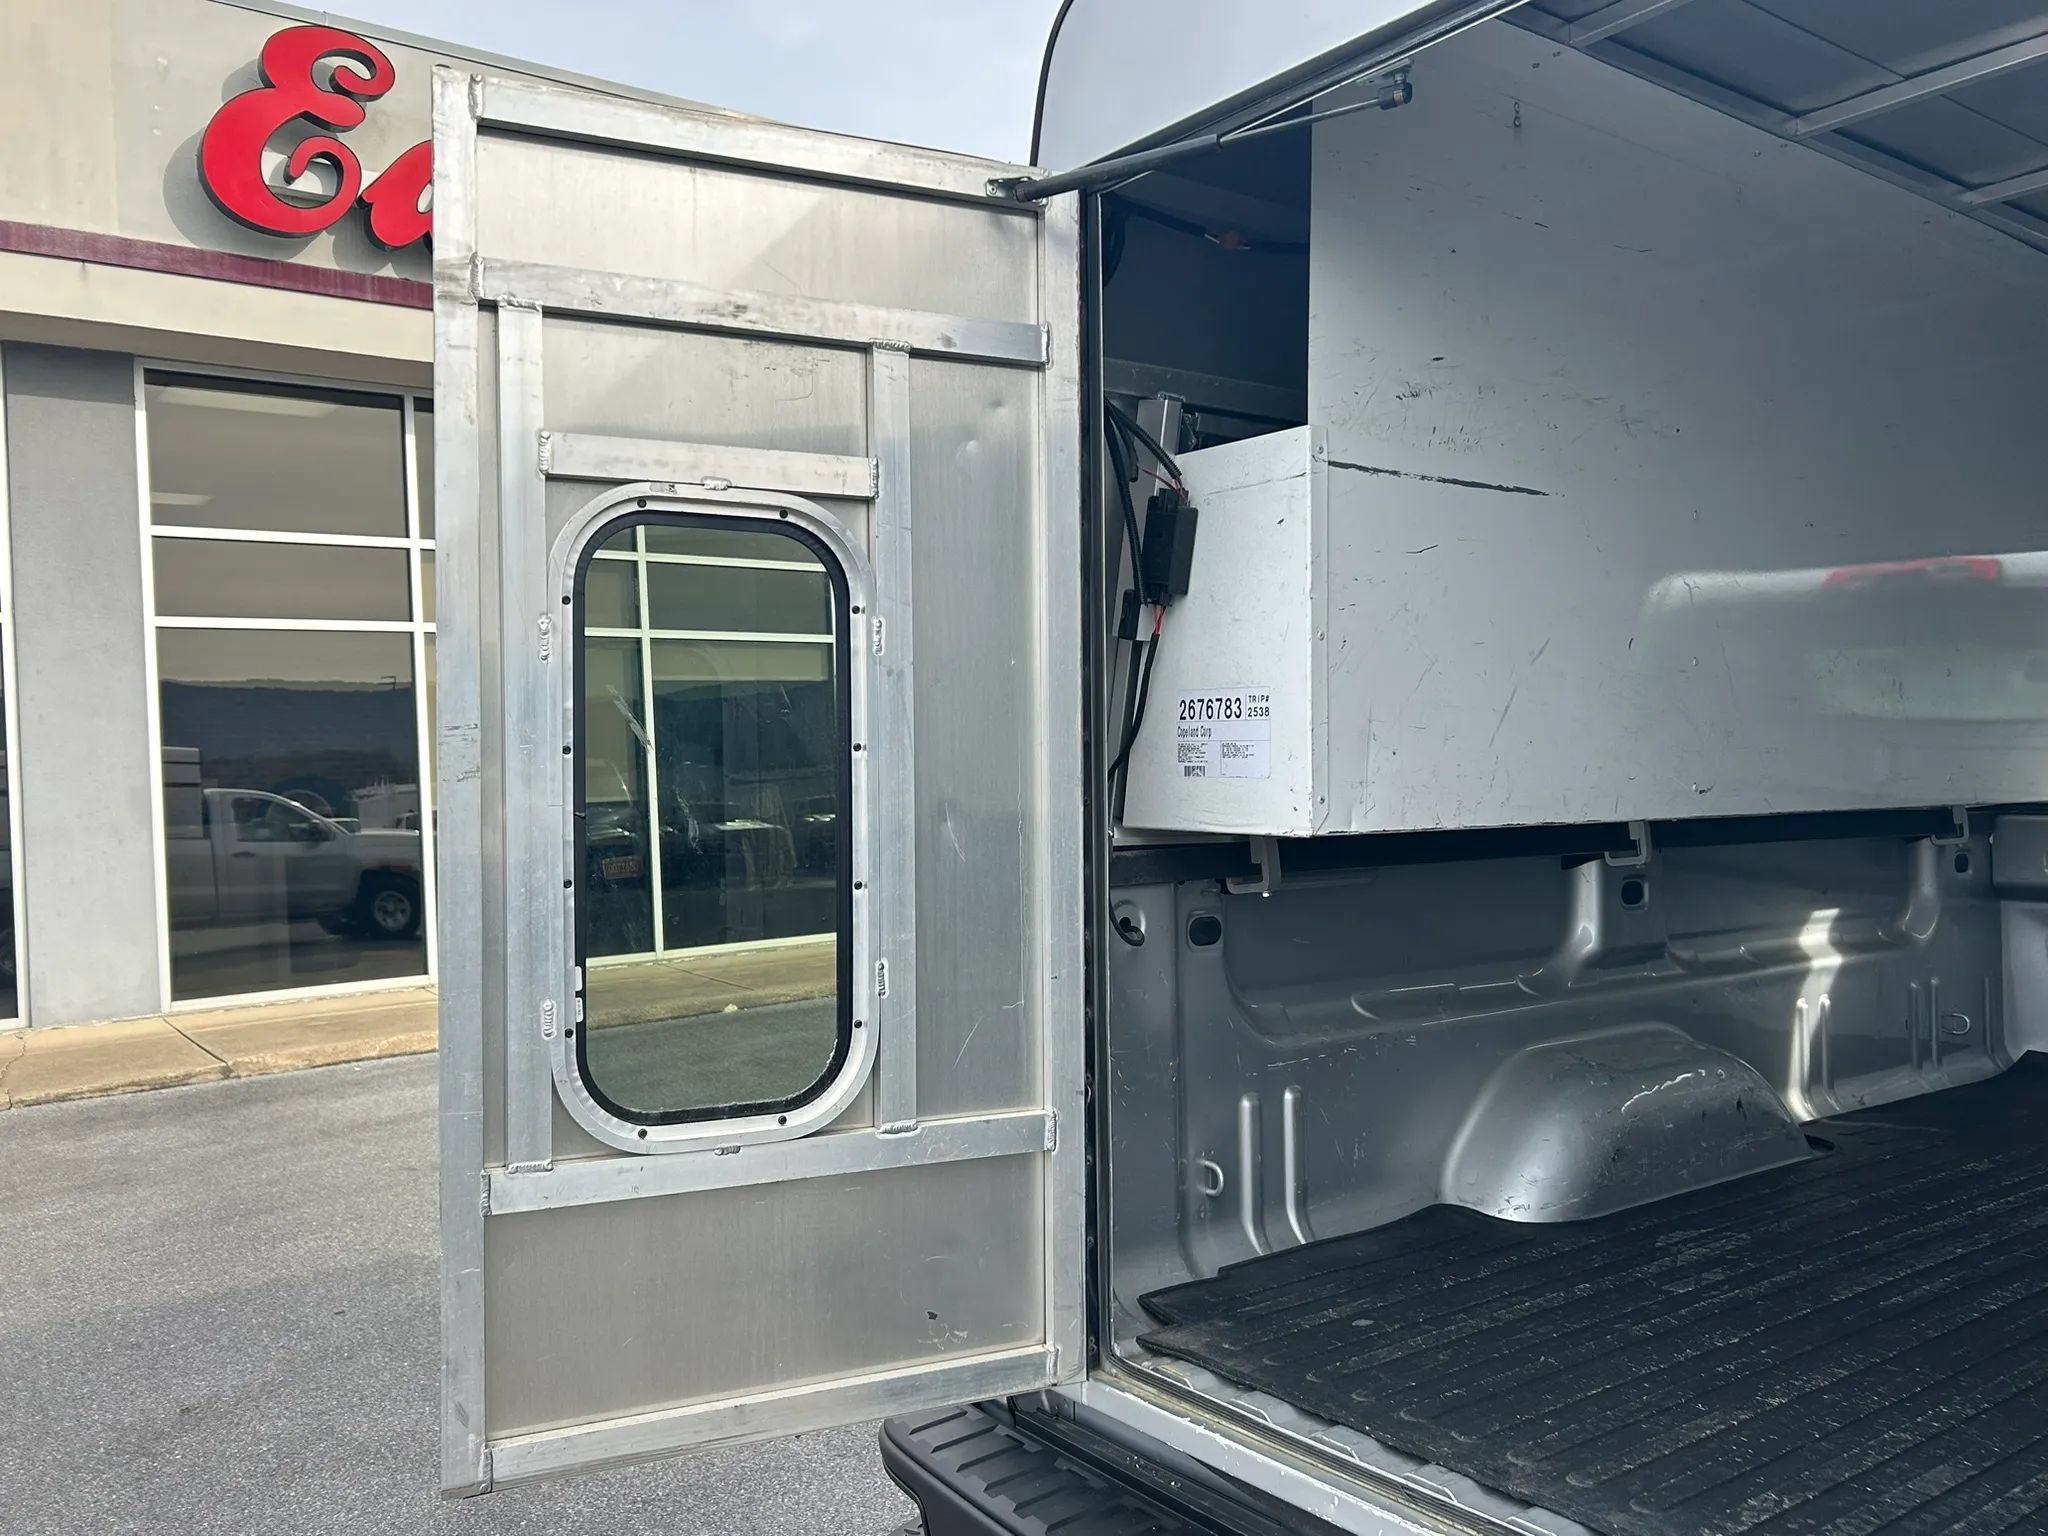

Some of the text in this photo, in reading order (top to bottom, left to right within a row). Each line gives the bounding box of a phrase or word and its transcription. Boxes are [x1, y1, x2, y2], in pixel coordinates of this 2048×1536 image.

[1248, 695, 1270, 703] TRIP#
[1179, 697, 1242, 720] 2676783
[1247, 706, 1270, 717] 2538
[1177, 726, 1212, 739] Copeland Corp
